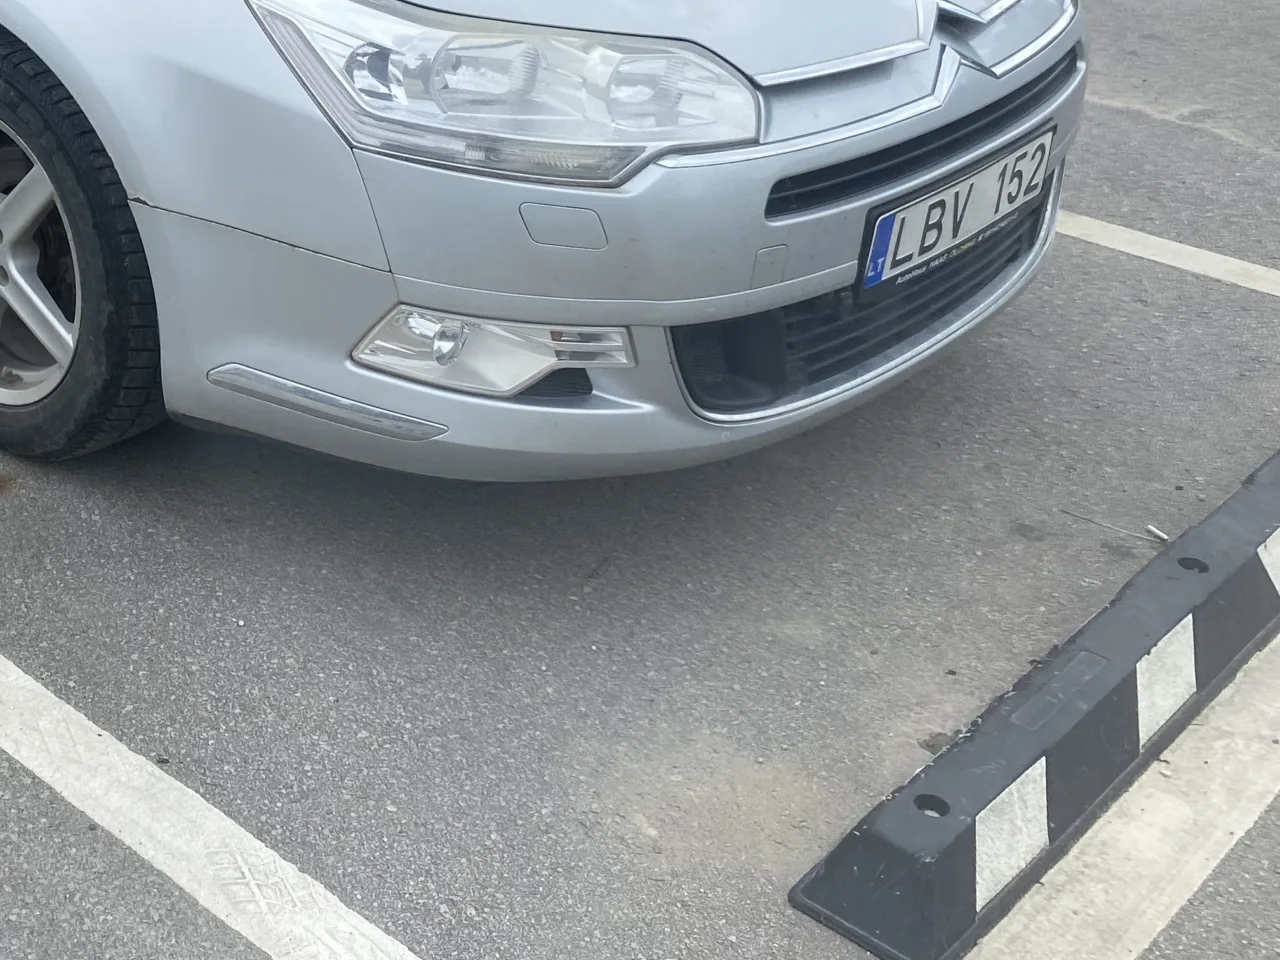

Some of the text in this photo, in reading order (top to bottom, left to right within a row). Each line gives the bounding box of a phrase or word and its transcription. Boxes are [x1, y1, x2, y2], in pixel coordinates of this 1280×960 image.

[889, 142, 1046, 271] LBV 152
[867, 257, 885, 277] LT
